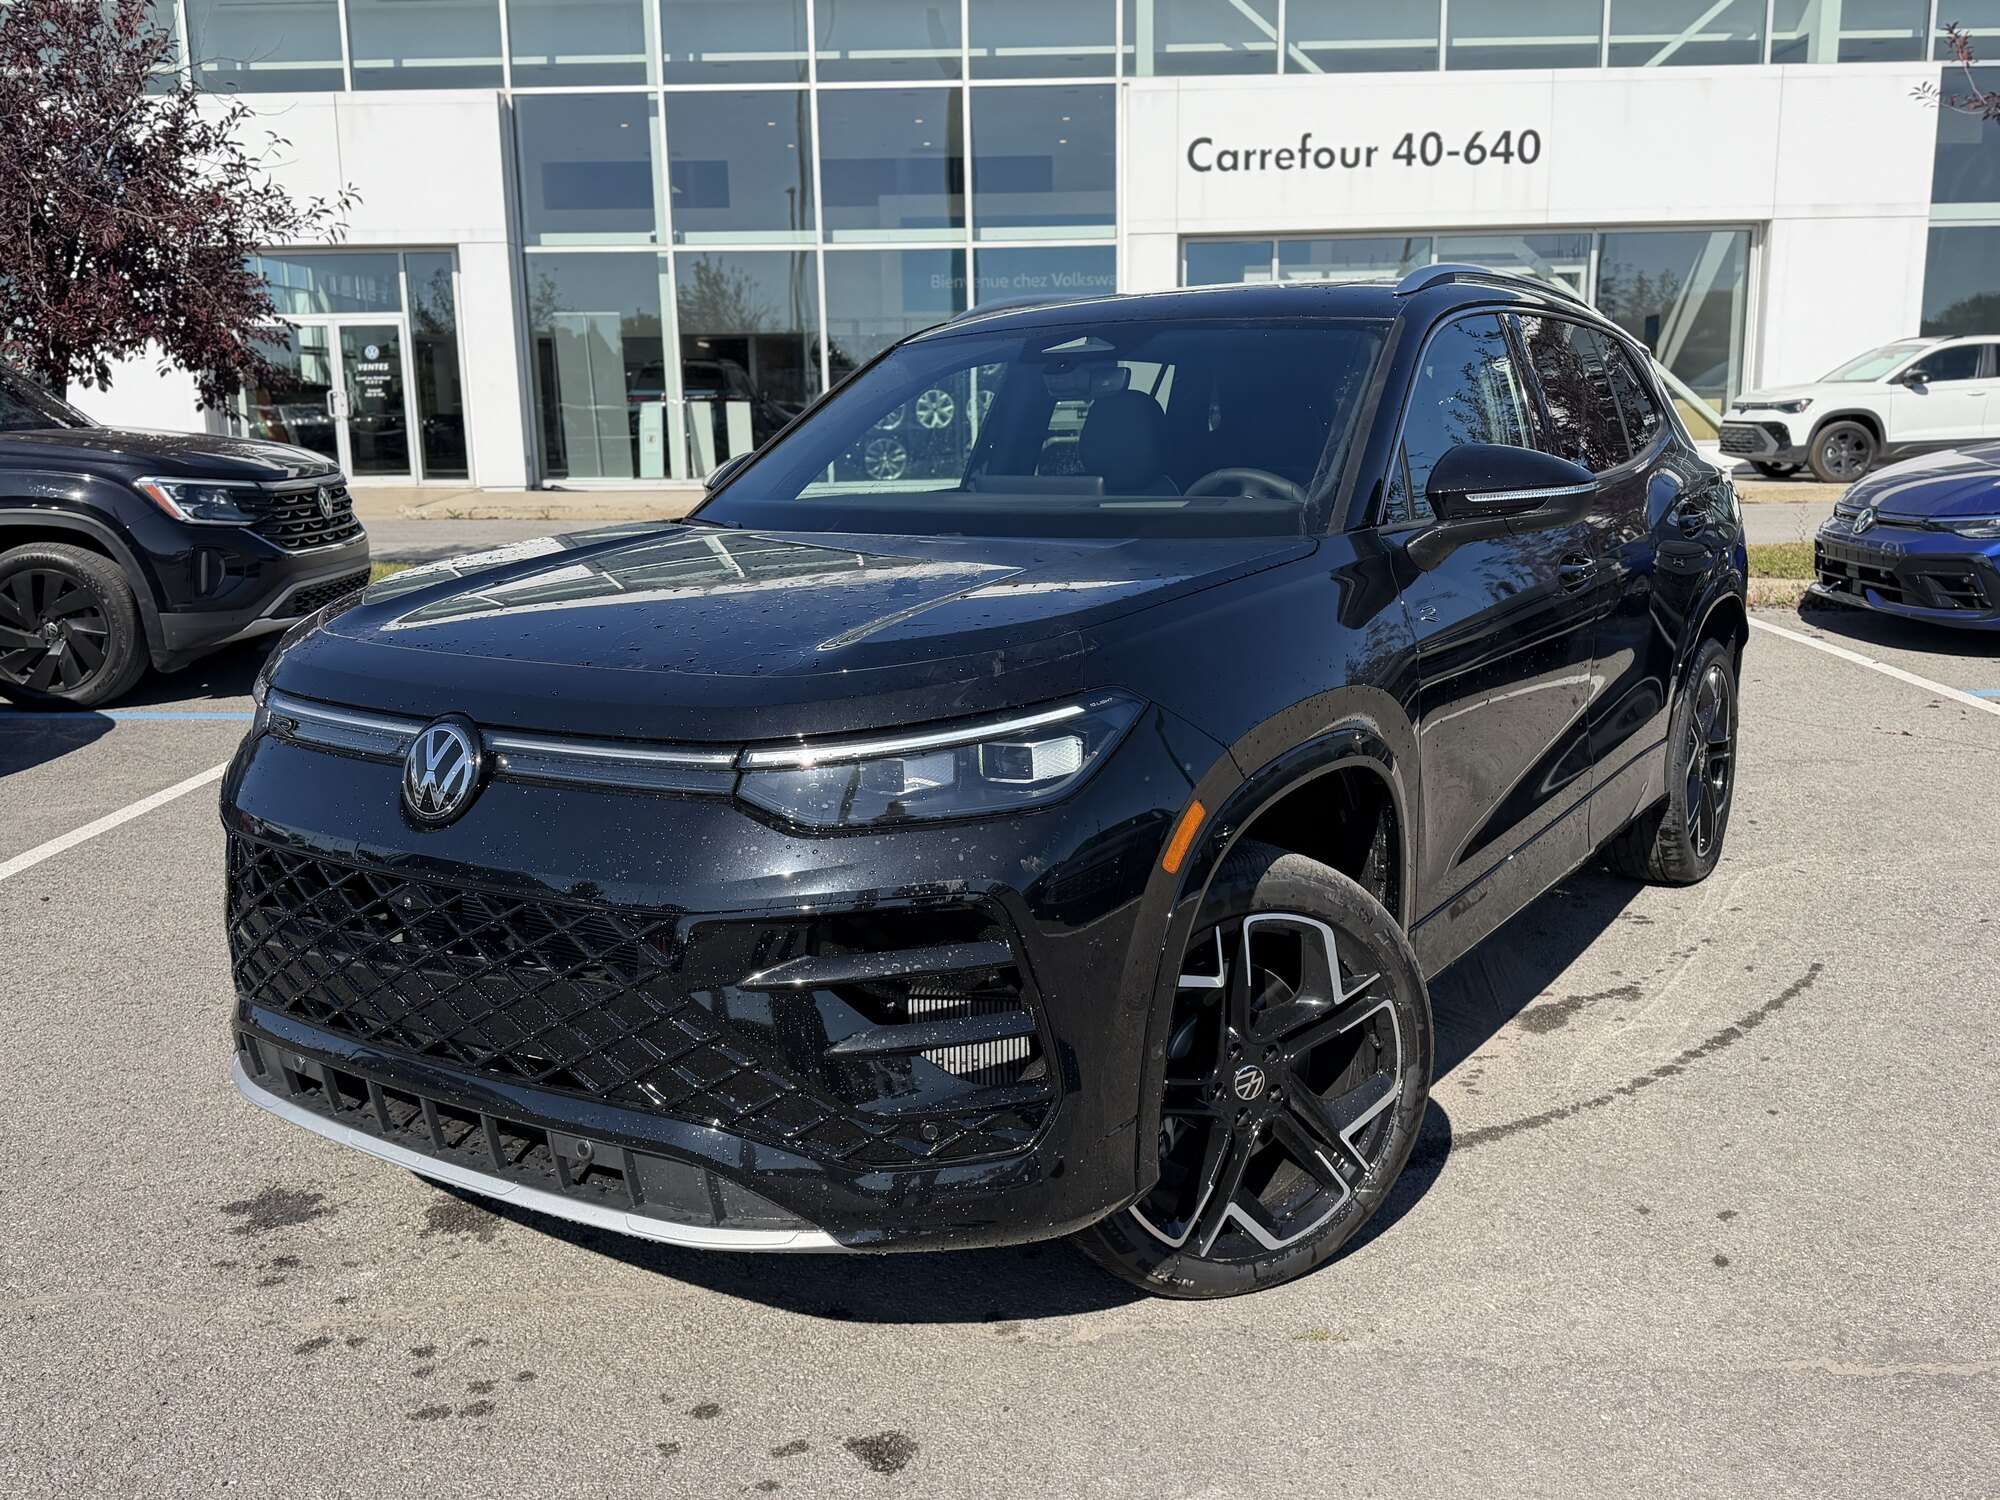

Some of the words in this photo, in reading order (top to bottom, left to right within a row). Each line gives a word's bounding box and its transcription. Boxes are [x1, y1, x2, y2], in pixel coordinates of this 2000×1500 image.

[1187, 133, 1379, 173] Carrefour
[1392, 129, 1542, 167] 40-640
[1013, 272, 1047, 288] chez
[357, 362, 389, 372] VENTES
[403, 722, 473, 820] VW
[1234, 1065, 1265, 1101] VW
